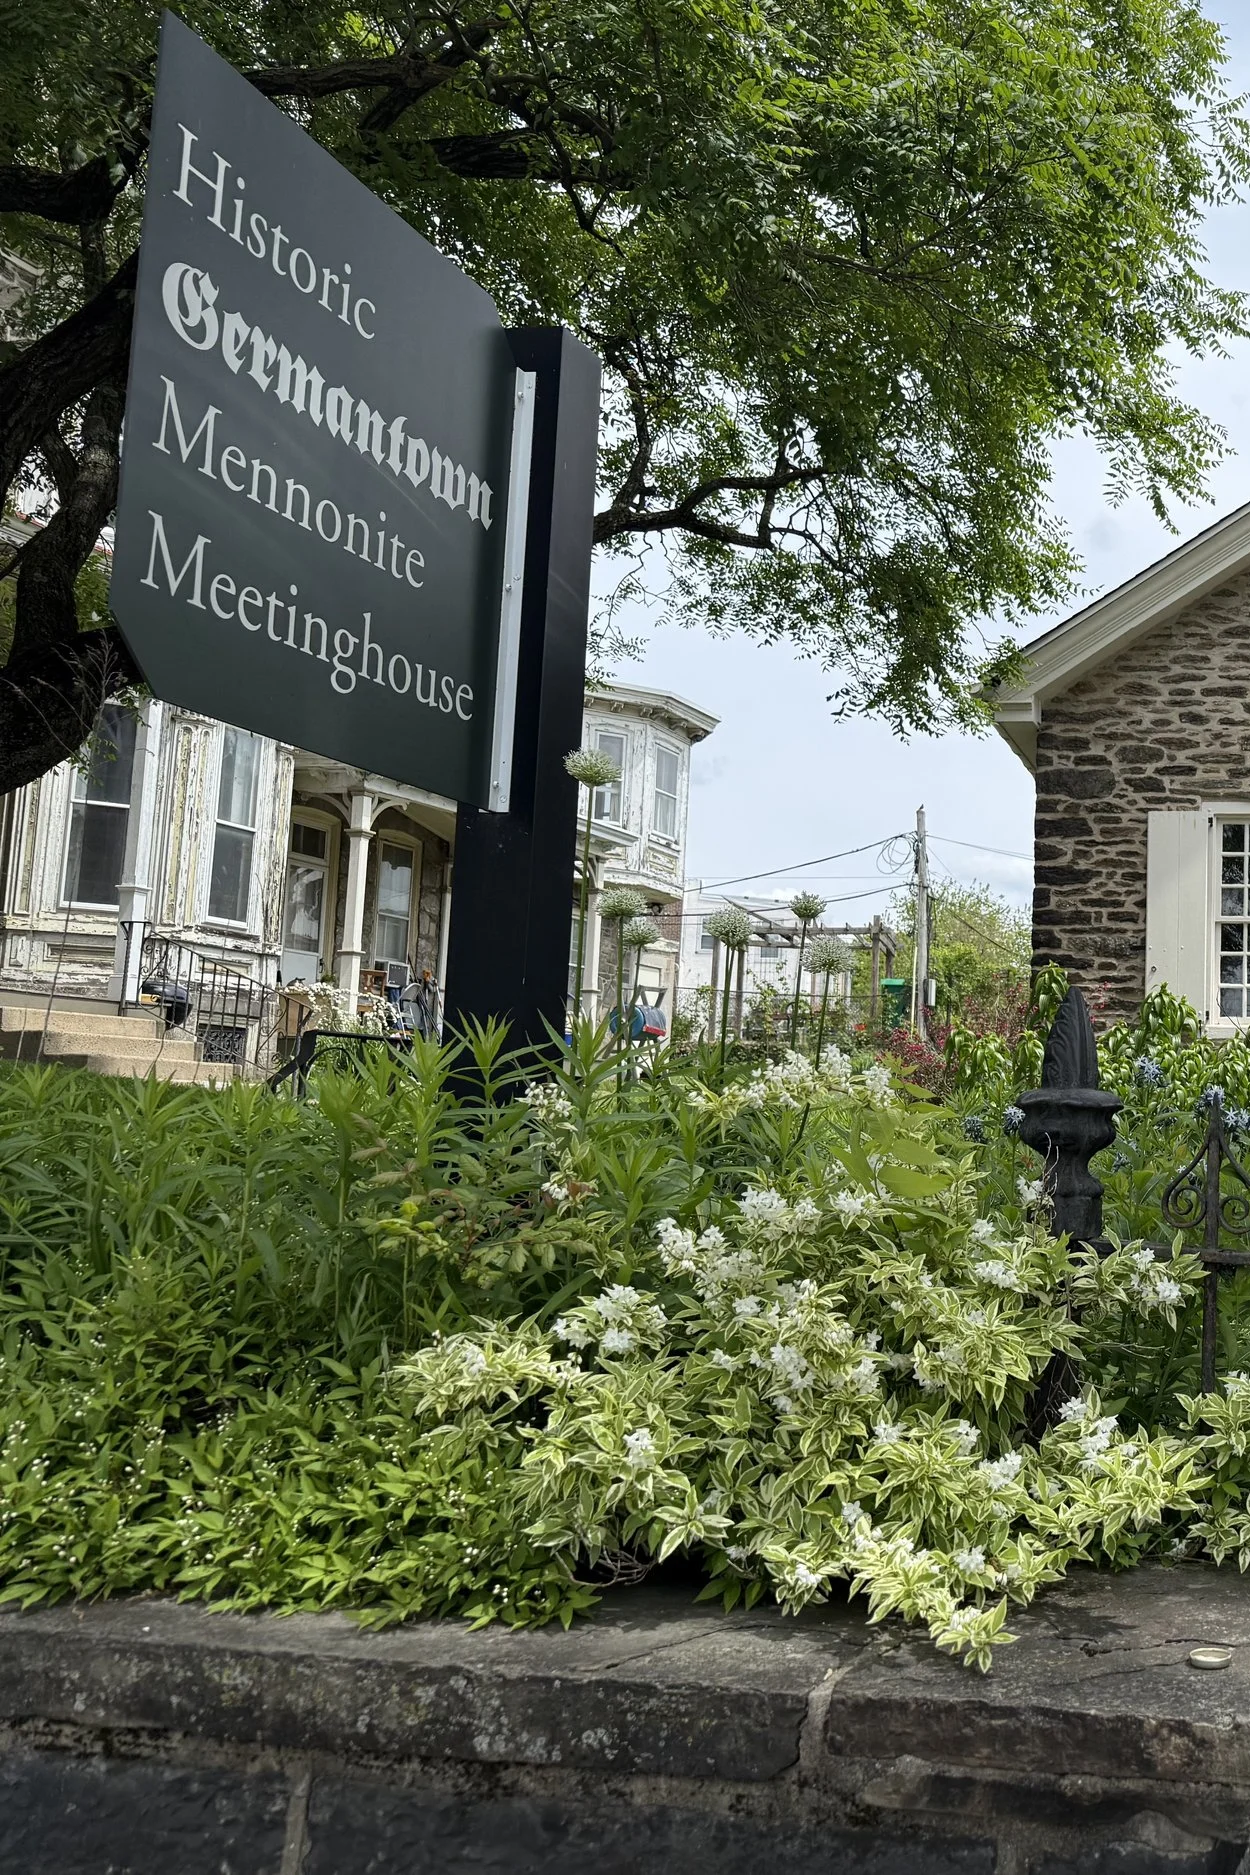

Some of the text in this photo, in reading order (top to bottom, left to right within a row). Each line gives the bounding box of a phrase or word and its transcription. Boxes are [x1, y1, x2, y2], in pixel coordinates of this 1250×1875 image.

[173, 122, 376, 341] Historic
[152, 376, 426, 589] Mennonite
[162, 262, 494, 531] Germantown
[140, 510, 474, 720] Meetinghouse
